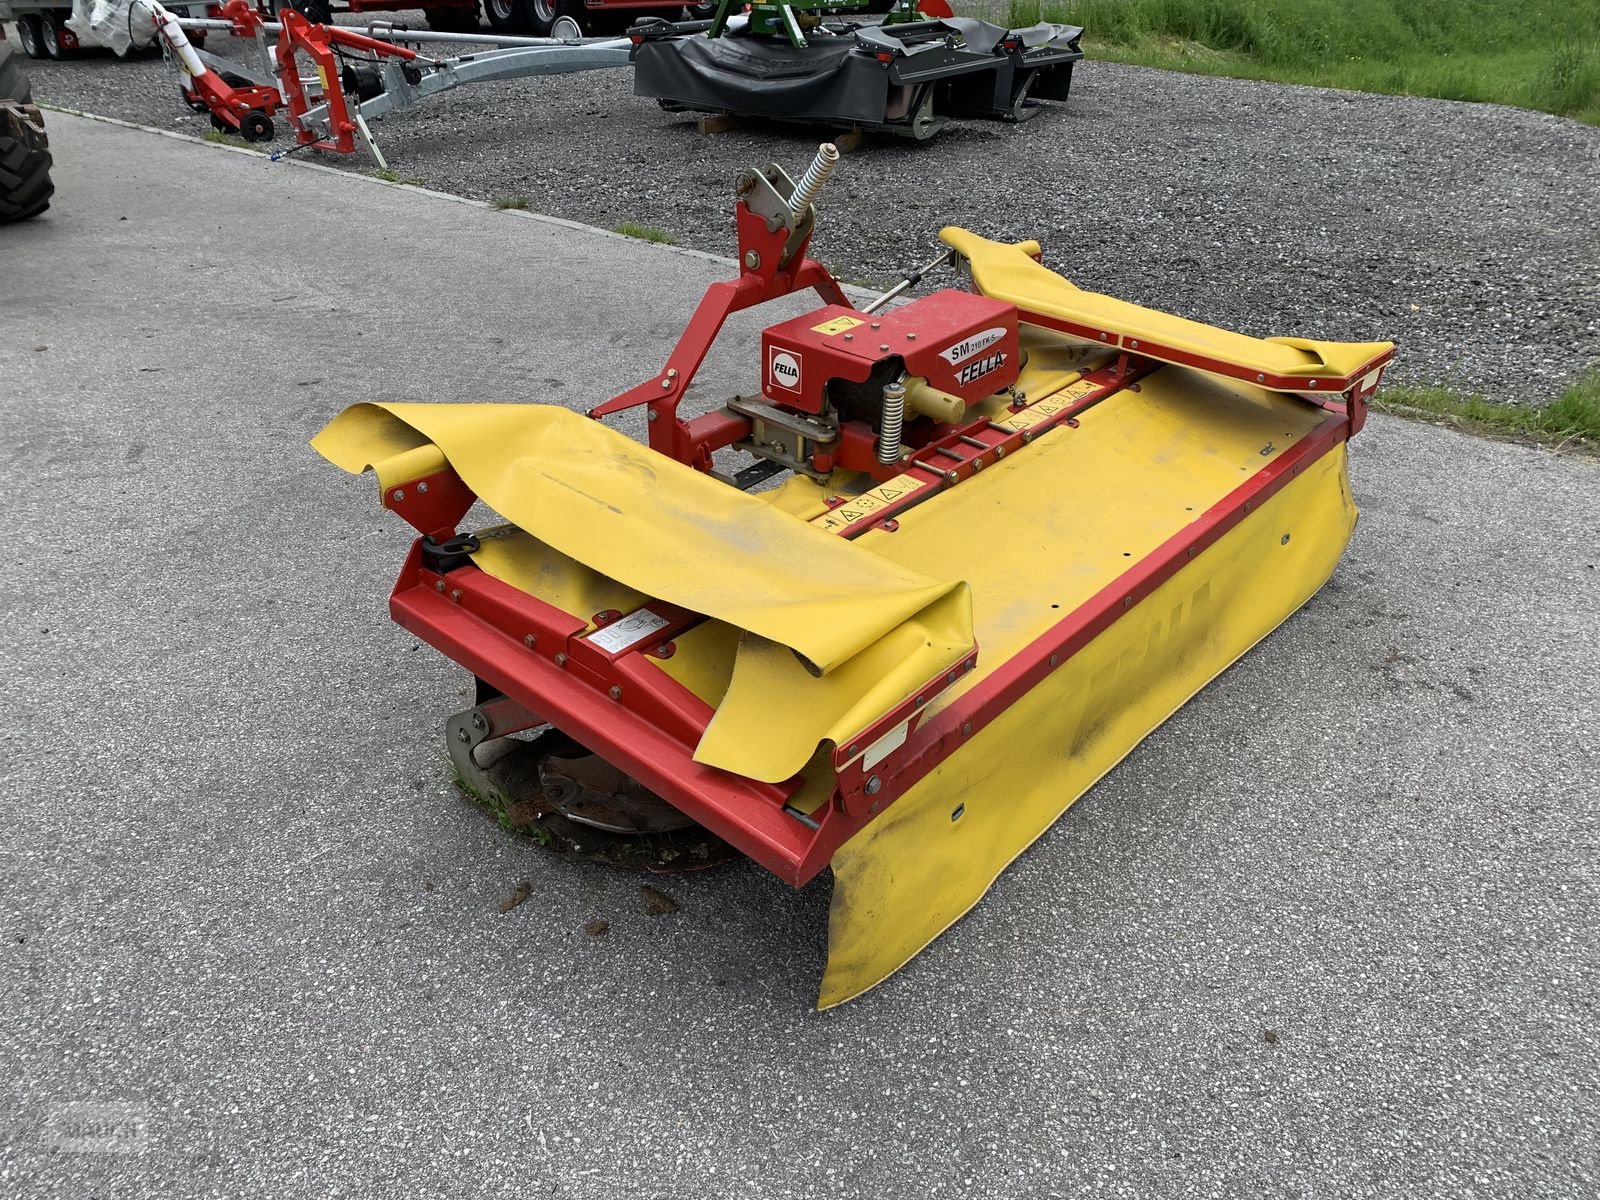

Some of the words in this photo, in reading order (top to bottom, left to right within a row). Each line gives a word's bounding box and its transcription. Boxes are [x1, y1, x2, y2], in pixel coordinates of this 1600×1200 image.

[951, 342, 970, 361] SM
[970, 340, 982, 353] 210
[774, 362, 798, 378] FELLA
[960, 350, 1004, 387] FELLA
